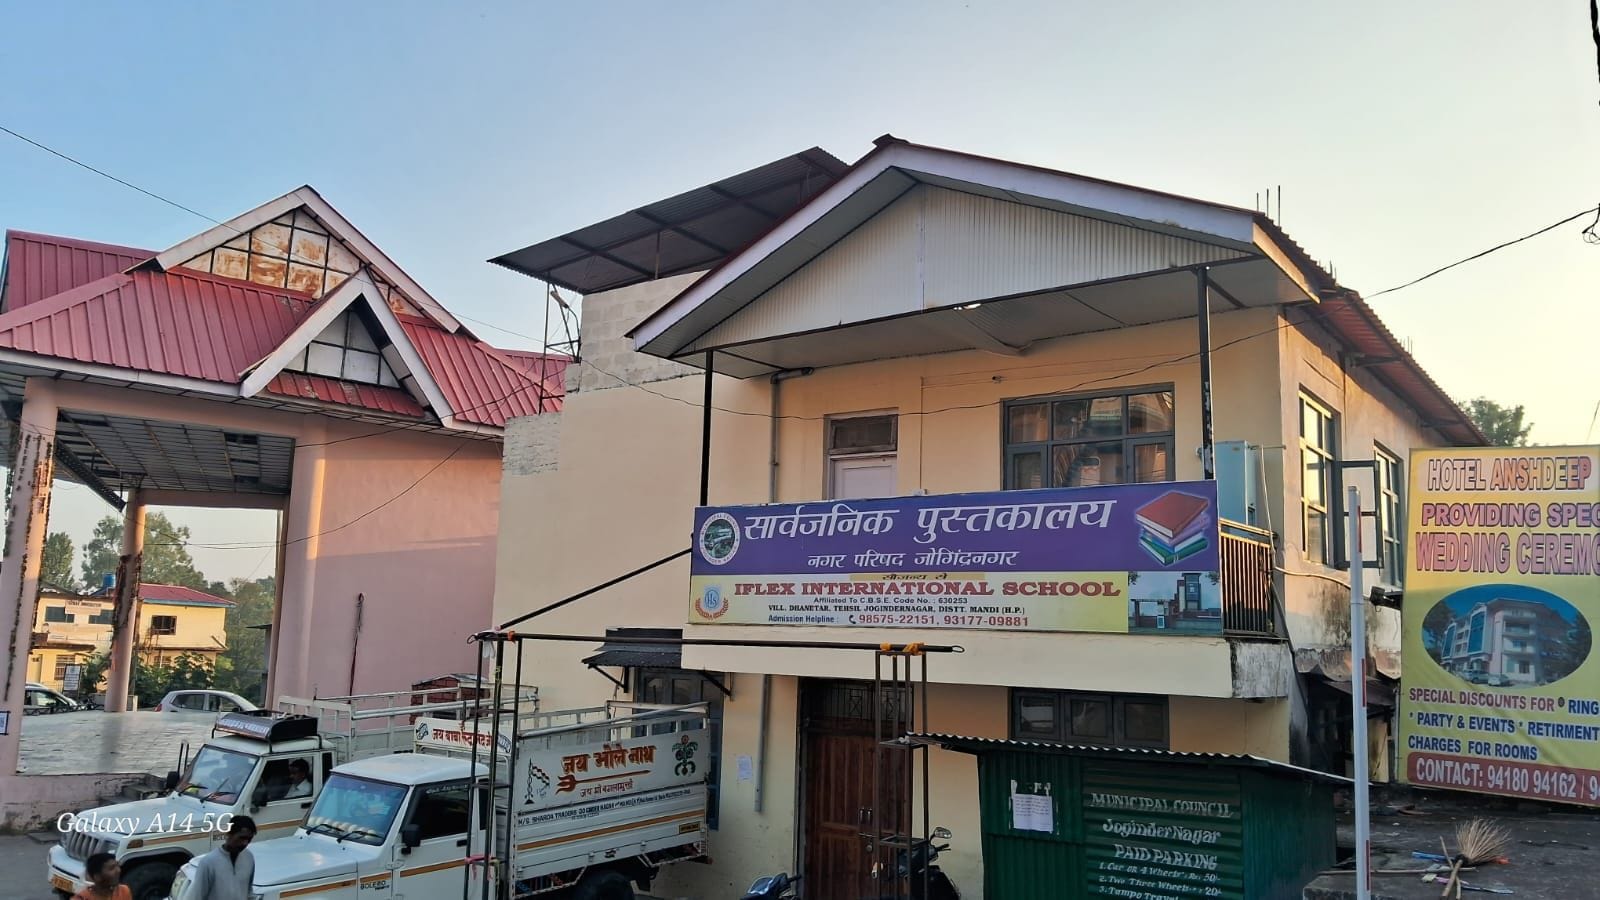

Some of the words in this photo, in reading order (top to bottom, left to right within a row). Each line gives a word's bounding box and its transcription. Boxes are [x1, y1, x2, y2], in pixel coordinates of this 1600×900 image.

[1427, 458, 1486, 491] HOTEL
[1489, 456, 1592, 491] ANSHDEEP
[744, 503, 900, 540] सार्वजनिक
[913, 499, 1117, 543] पुस्तकालय
[1421, 502, 1541, 528] PROVIDING
[807, 554, 847, 568] नगर
[854, 549, 906, 567] परिषद
[914, 547, 1020, 566] जोगिंद्रनगर
[1415, 532, 1510, 573] WEDDING
[734, 582, 795, 596] IFLEX
[801, 581, 994, 596] INTERNATIONAL
[1002, 581, 1121, 597] SCHOOL
[768, 614, 803, 622] Admission
[805, 615, 835, 624] Helpline
[943, 615, 1028, 627] 93177-09881
[1001, 607, 1025, 615] (H.P.)
[1409, 687, 1456, 704] SPECIAL
[1459, 691, 1527, 710] DISCOUNTS
[1530, 696, 1555, 712] FOR
[1568, 699, 1600, 716] RING
[1417, 712, 1453, 728] PARTY
[1457, 715, 1465, 728] &
[1469, 716, 1515, 733] EVENTS
[1528, 721, 1600, 741] RETIRMENT
[562, 754, 591, 774] जय
[593, 744, 629, 769] भोले
[629, 745, 657, 765] नाथ
[1408, 735, 1461, 753] CHARGES
[1468, 741, 1491, 756] FOR
[1495, 743, 1538, 760] ROOMS
[1416, 757, 1483, 787] CONTACT:
[1487, 765, 1529, 793] 94180
[1533, 771, 1577, 798] 94162
[1089, 793, 1172, 813] MUNICIPAL
[1173, 799, 1234, 818] COUNCIL
[1114, 844, 1151, 861] PAID
[1151, 848, 1218, 870] PARKING
